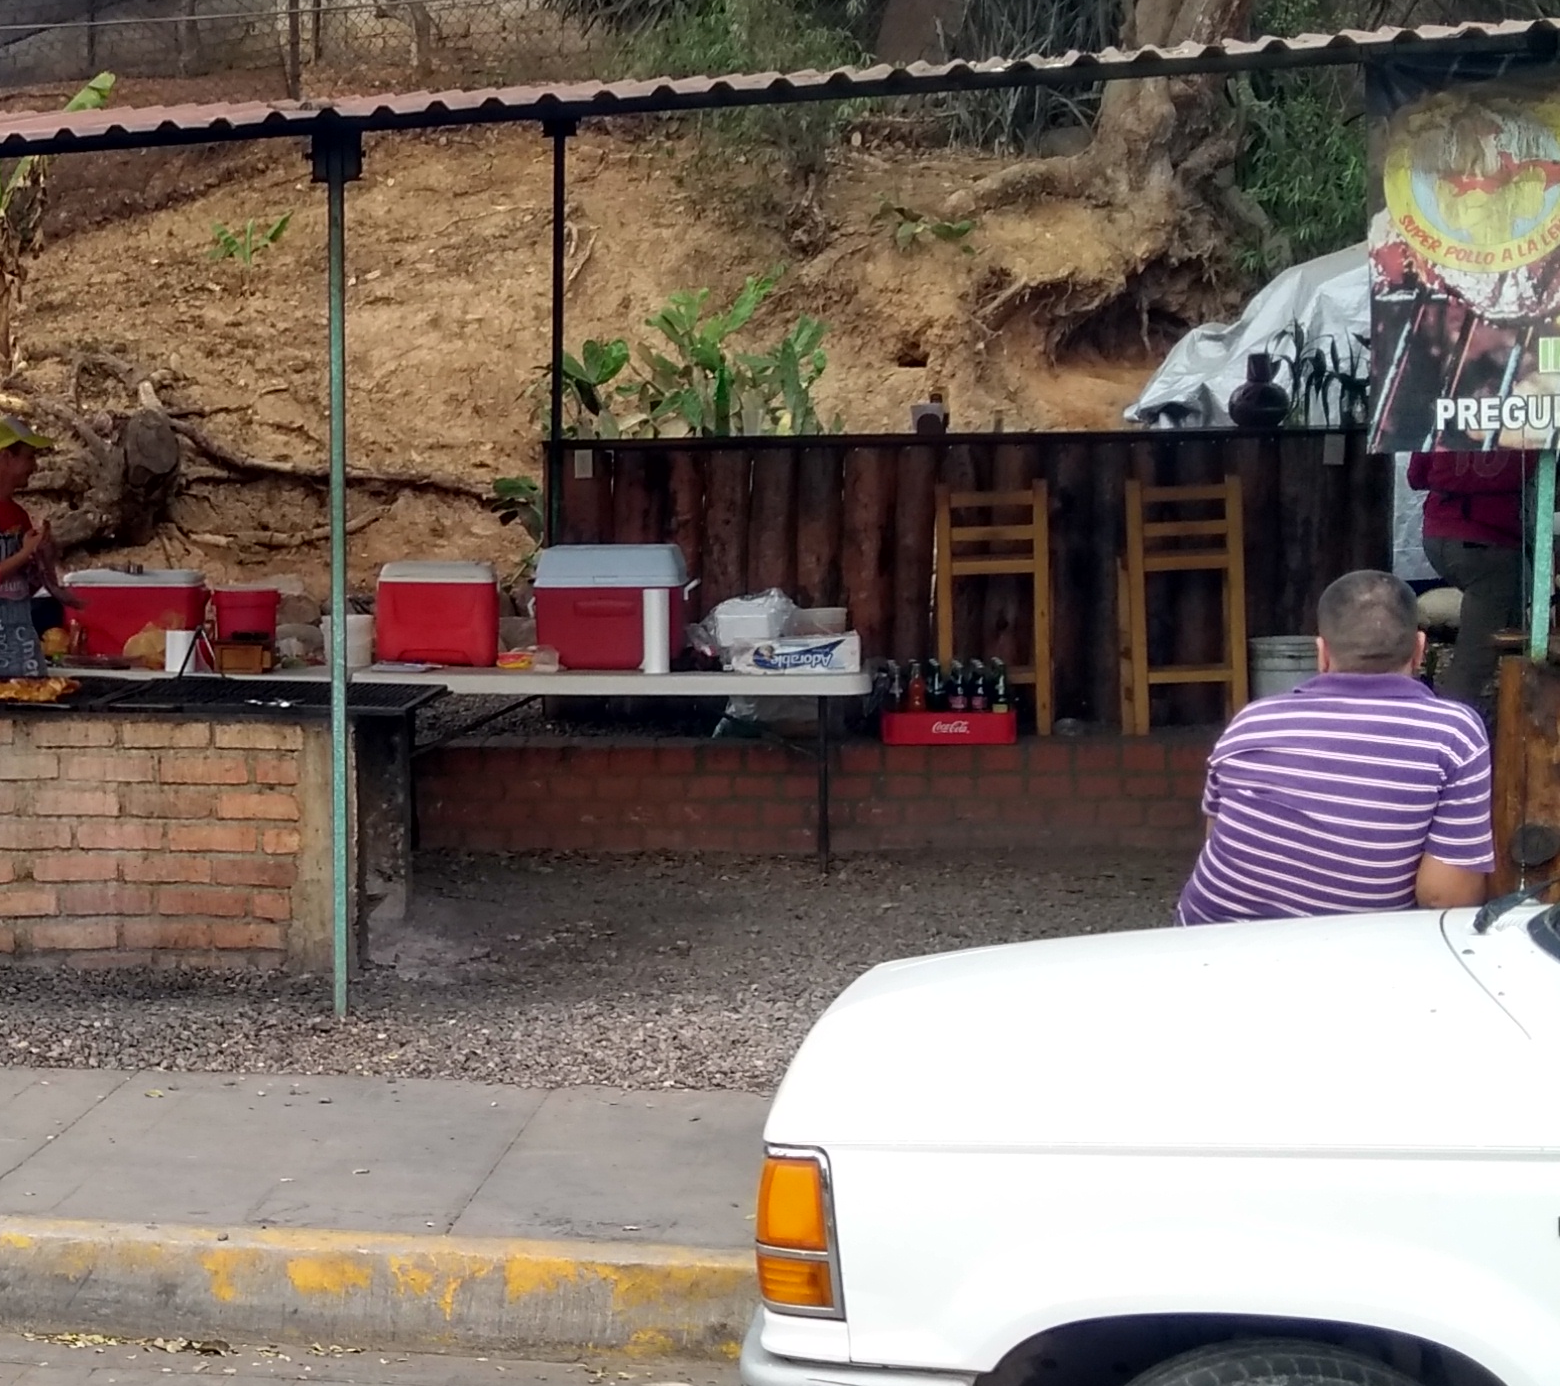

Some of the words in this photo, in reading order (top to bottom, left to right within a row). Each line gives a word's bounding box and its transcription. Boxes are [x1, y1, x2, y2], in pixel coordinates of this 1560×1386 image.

[1399, 214, 1442, 253] SUPER
[1444, 245, 1495, 265] POLLO
[1501, 247, 1514, 263] A
[1517, 239, 1539, 258] LA
[770, 652, 834, 669] Adorable
